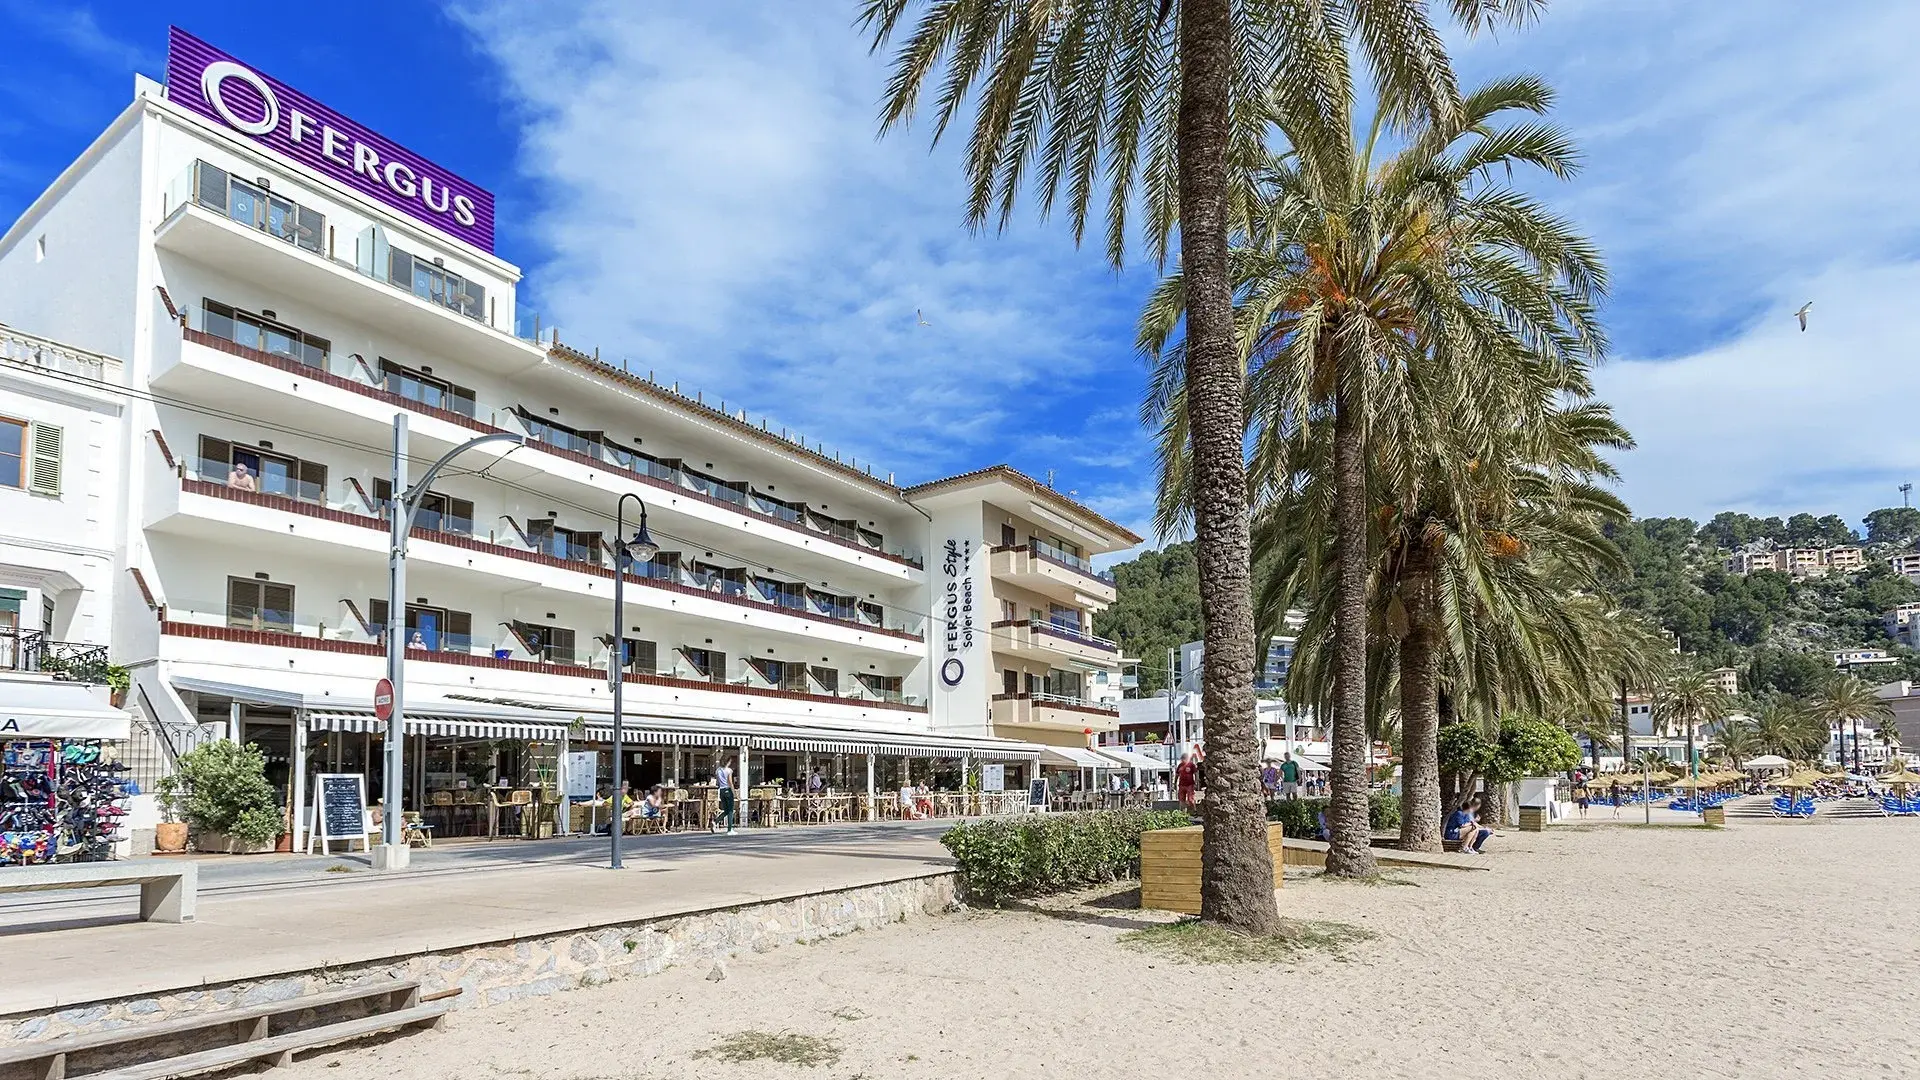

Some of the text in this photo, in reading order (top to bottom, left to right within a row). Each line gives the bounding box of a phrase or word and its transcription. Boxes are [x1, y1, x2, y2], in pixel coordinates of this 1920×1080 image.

[290, 108, 476, 227] FERGUS
[943, 539, 962, 652] FERGUS Style
[962, 577, 973, 648] Soller Beach
[0, 718, 20, 732] A
